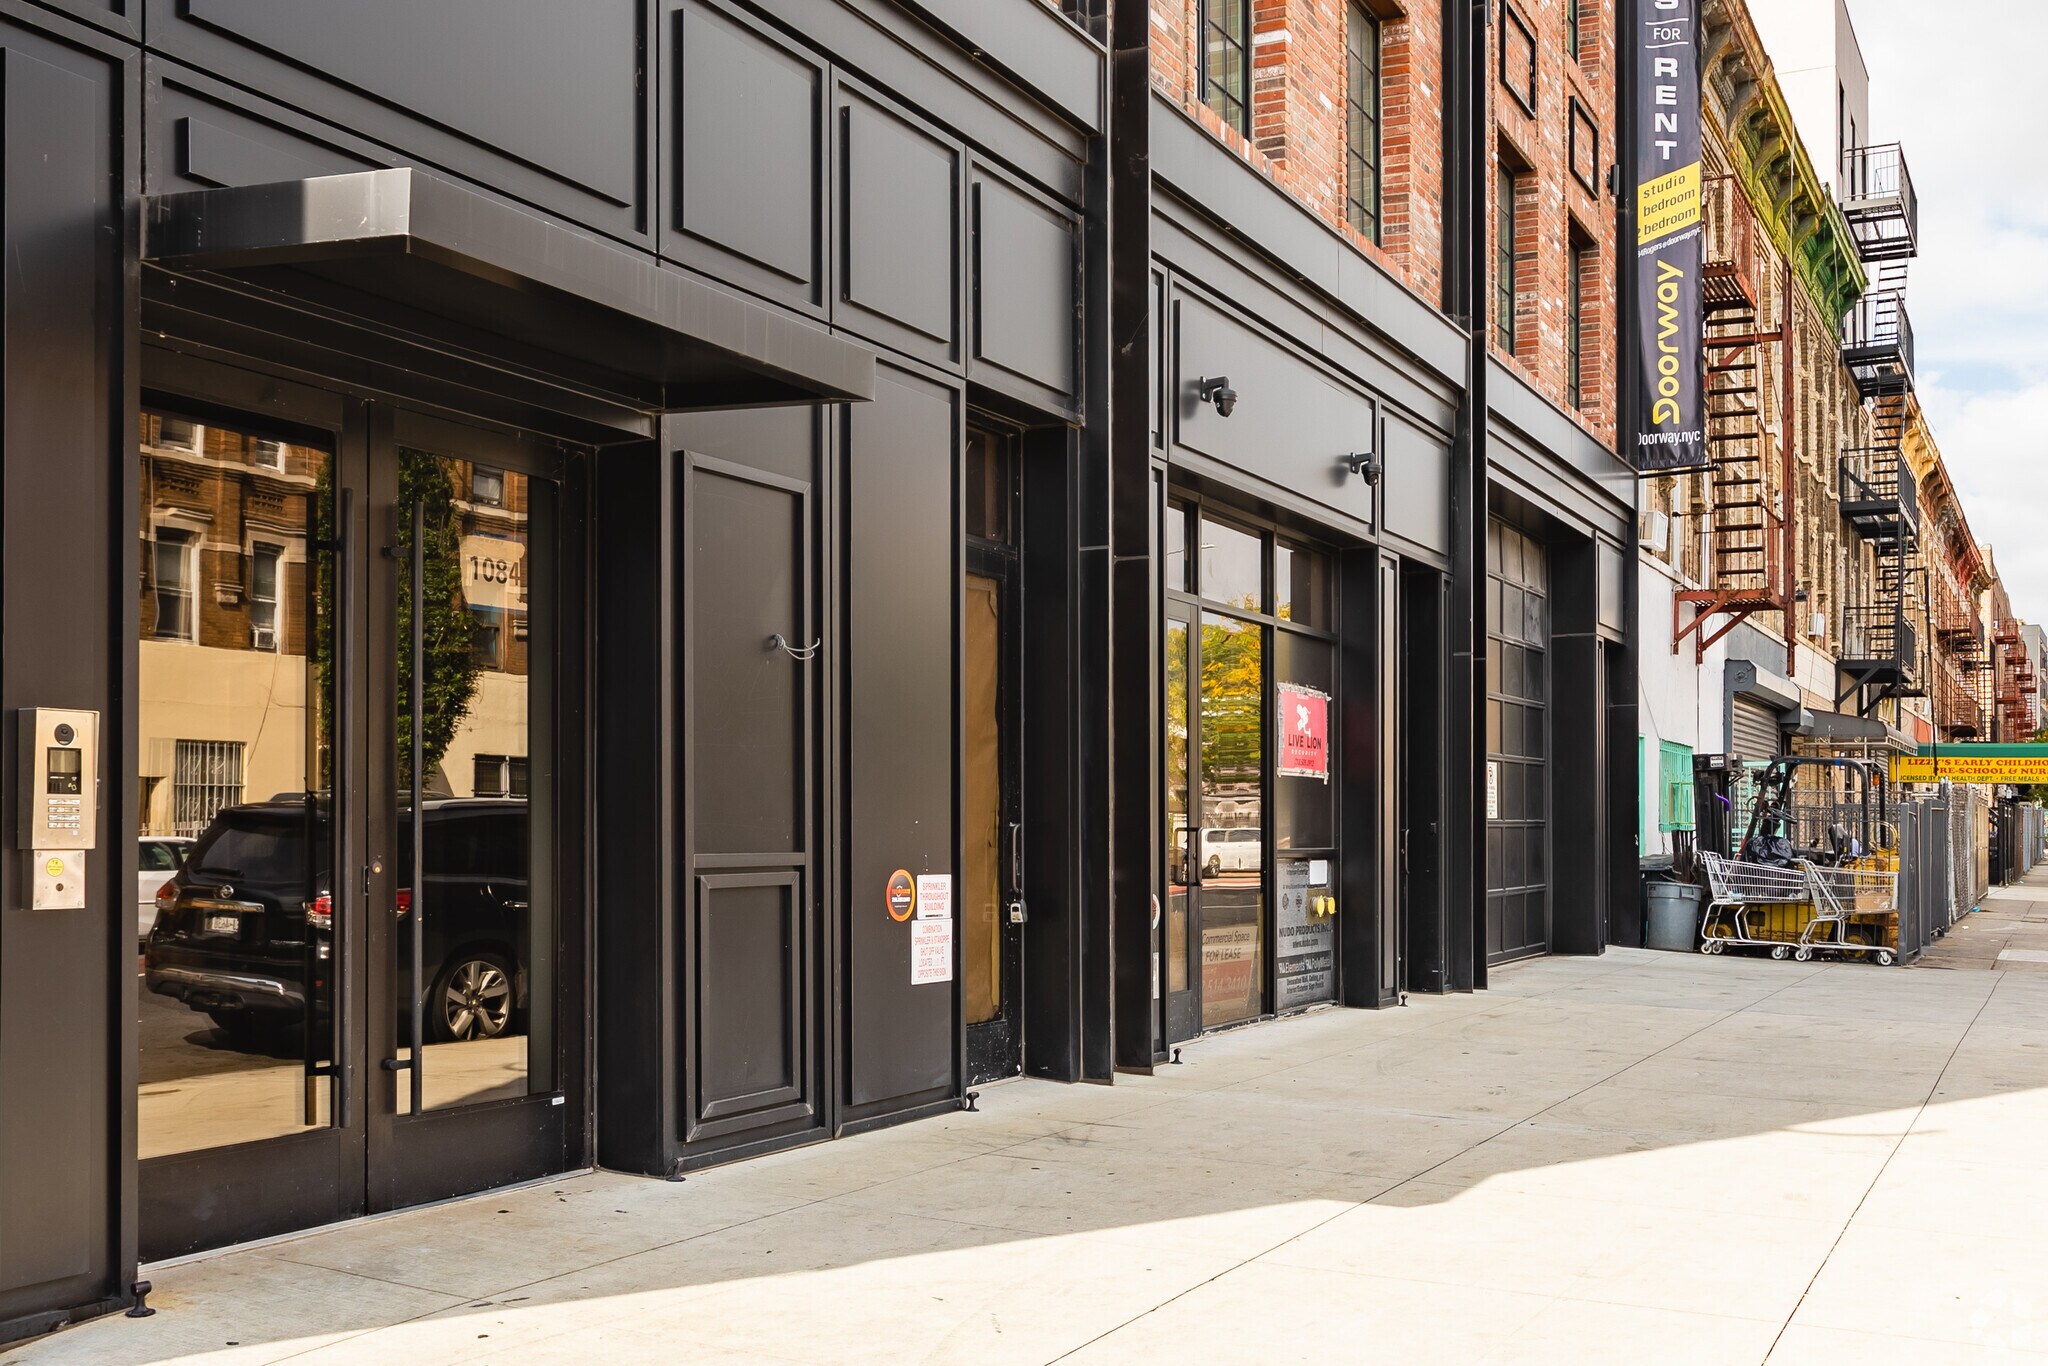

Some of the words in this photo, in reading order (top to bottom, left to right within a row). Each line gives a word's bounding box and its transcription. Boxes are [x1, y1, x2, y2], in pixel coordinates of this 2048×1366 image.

[1653, 27, 1681, 41] FOR
[1653, 57, 1678, 160] RENT
[1643, 174, 1686, 199] studio
[1643, 188, 1695, 217] bedroom
[1644, 207, 1696, 235] bedroom
[1652, 259, 1684, 425] Doorway
[470, 555, 521, 586] 1084
[1288, 734, 1304, 748] LIVE
[1306, 736, 1322, 750] LION
[1291, 748, 1318, 757] SECURITY
[1954, 759, 1993, 767] EARLY
[2008, 767, 2017, 775] &
[1202, 931, 1234, 945] Commercial
[1234, 930, 1250, 944] Space
[1279, 926, 1295, 938] NUDO
[1206, 949, 1220, 962] FOR
[1221, 947, 1242, 960] LEASE
